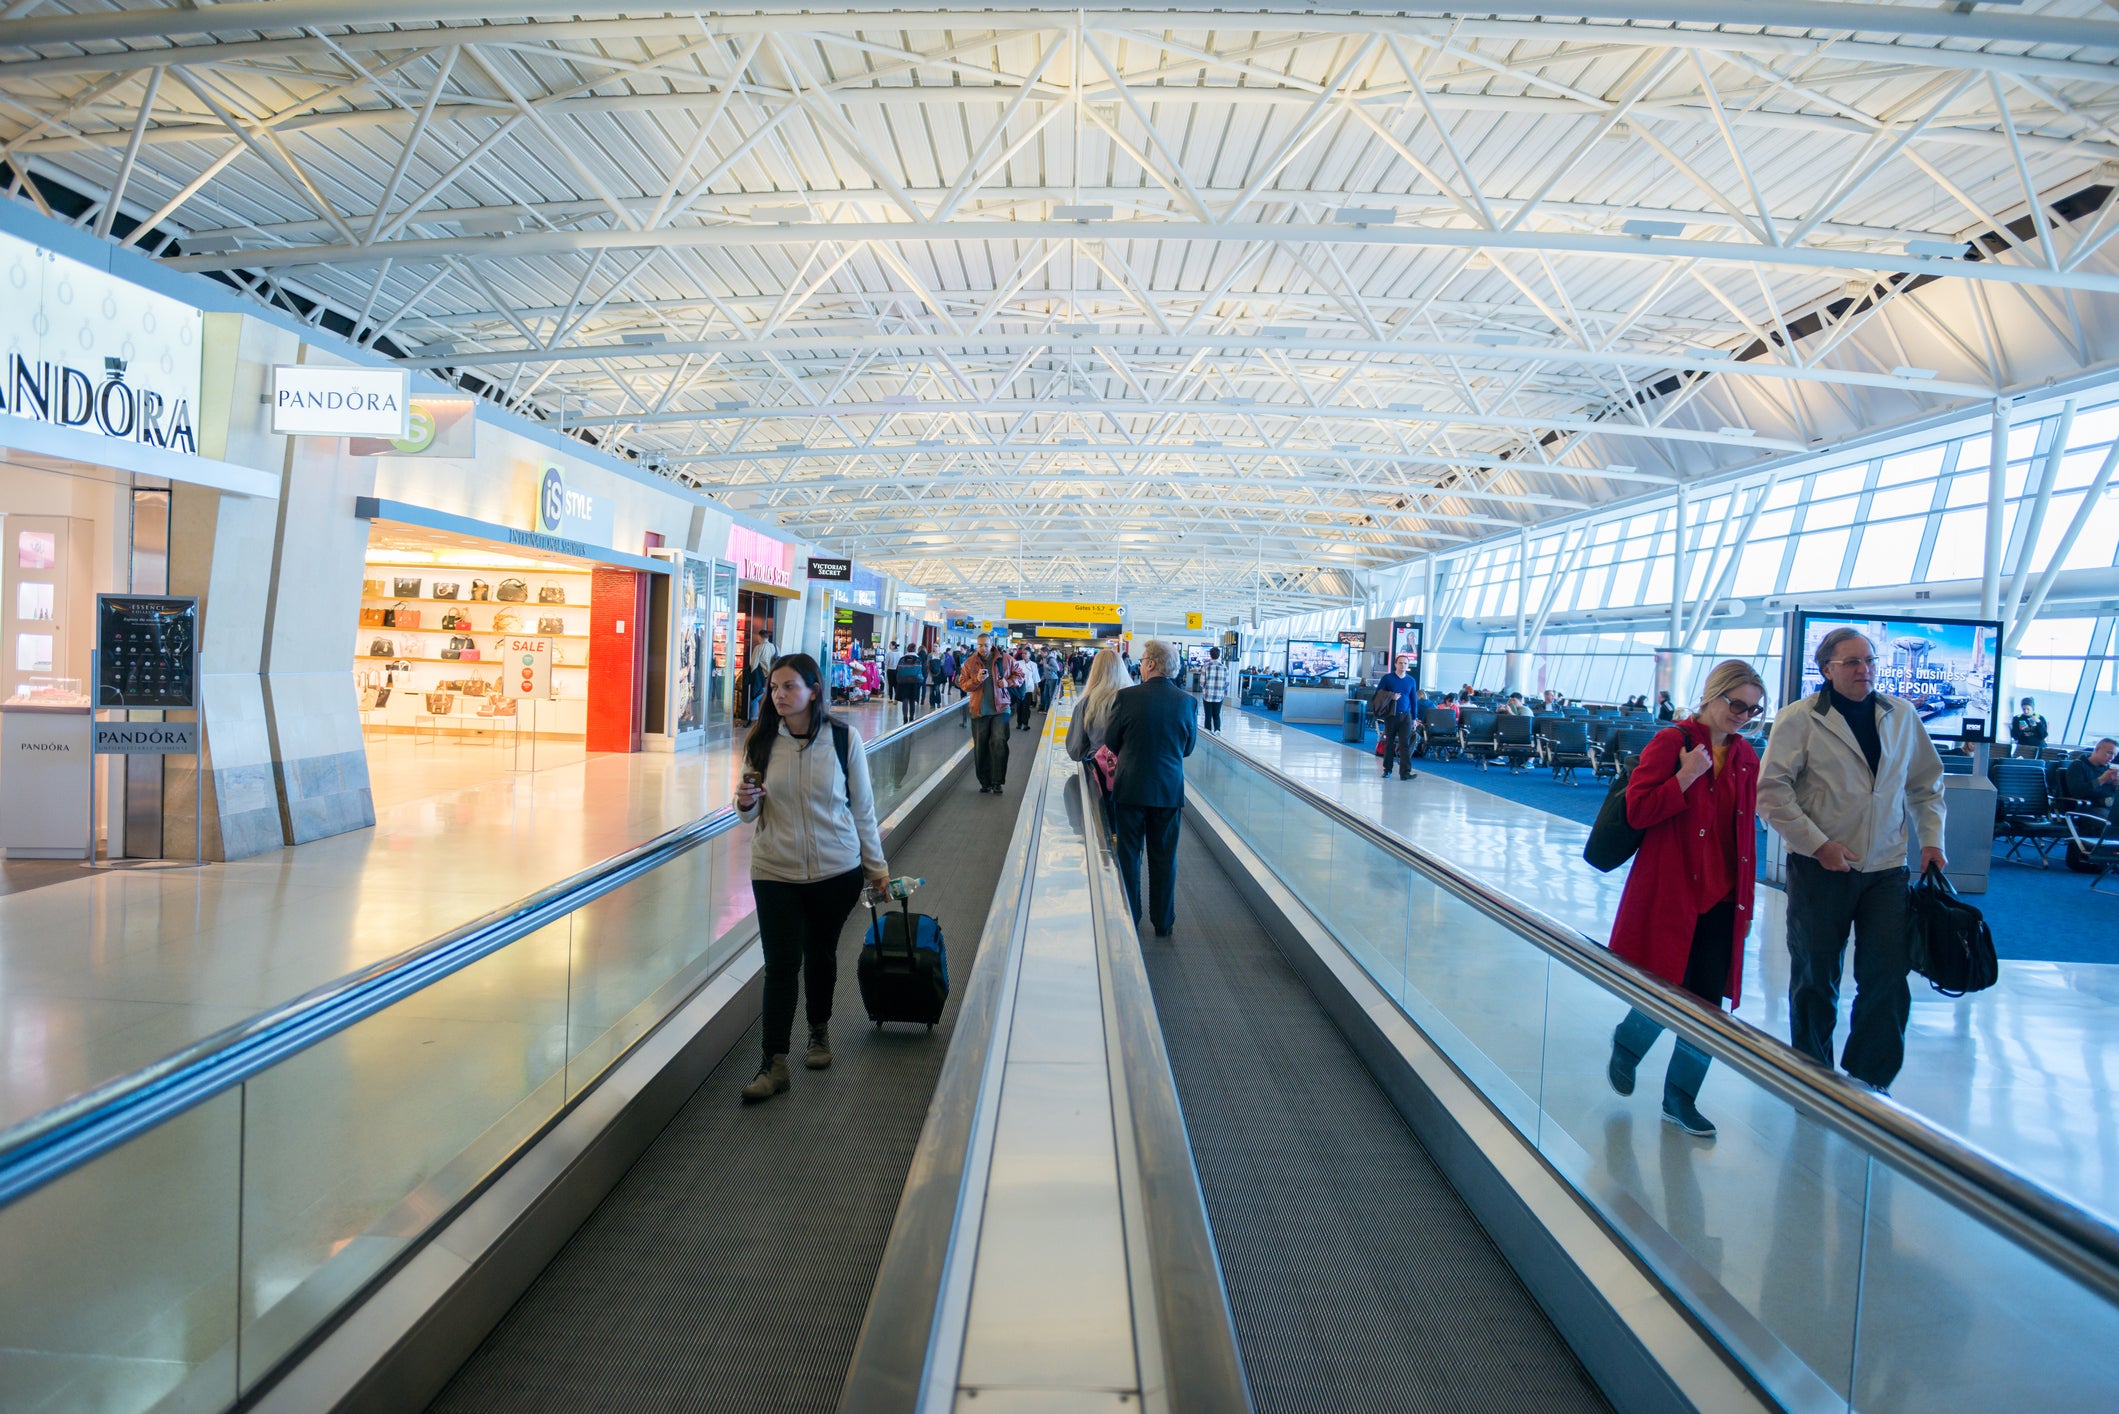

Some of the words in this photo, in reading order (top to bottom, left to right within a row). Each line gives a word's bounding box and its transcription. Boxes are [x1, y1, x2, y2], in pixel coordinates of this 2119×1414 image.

[0, 353, 199, 456] NDORA
[279, 388, 397, 412] PANDORA
[565, 490, 593, 521] STYLE
[812, 562, 847, 571] VICTORIA'S
[512, 640, 545, 652] SALE
[1875, 666, 1913, 679] here's
[1898, 682, 1940, 694] EPSON.
[98, 730, 187, 744] PANDORA
[21, 742, 70, 752] PANDORA
